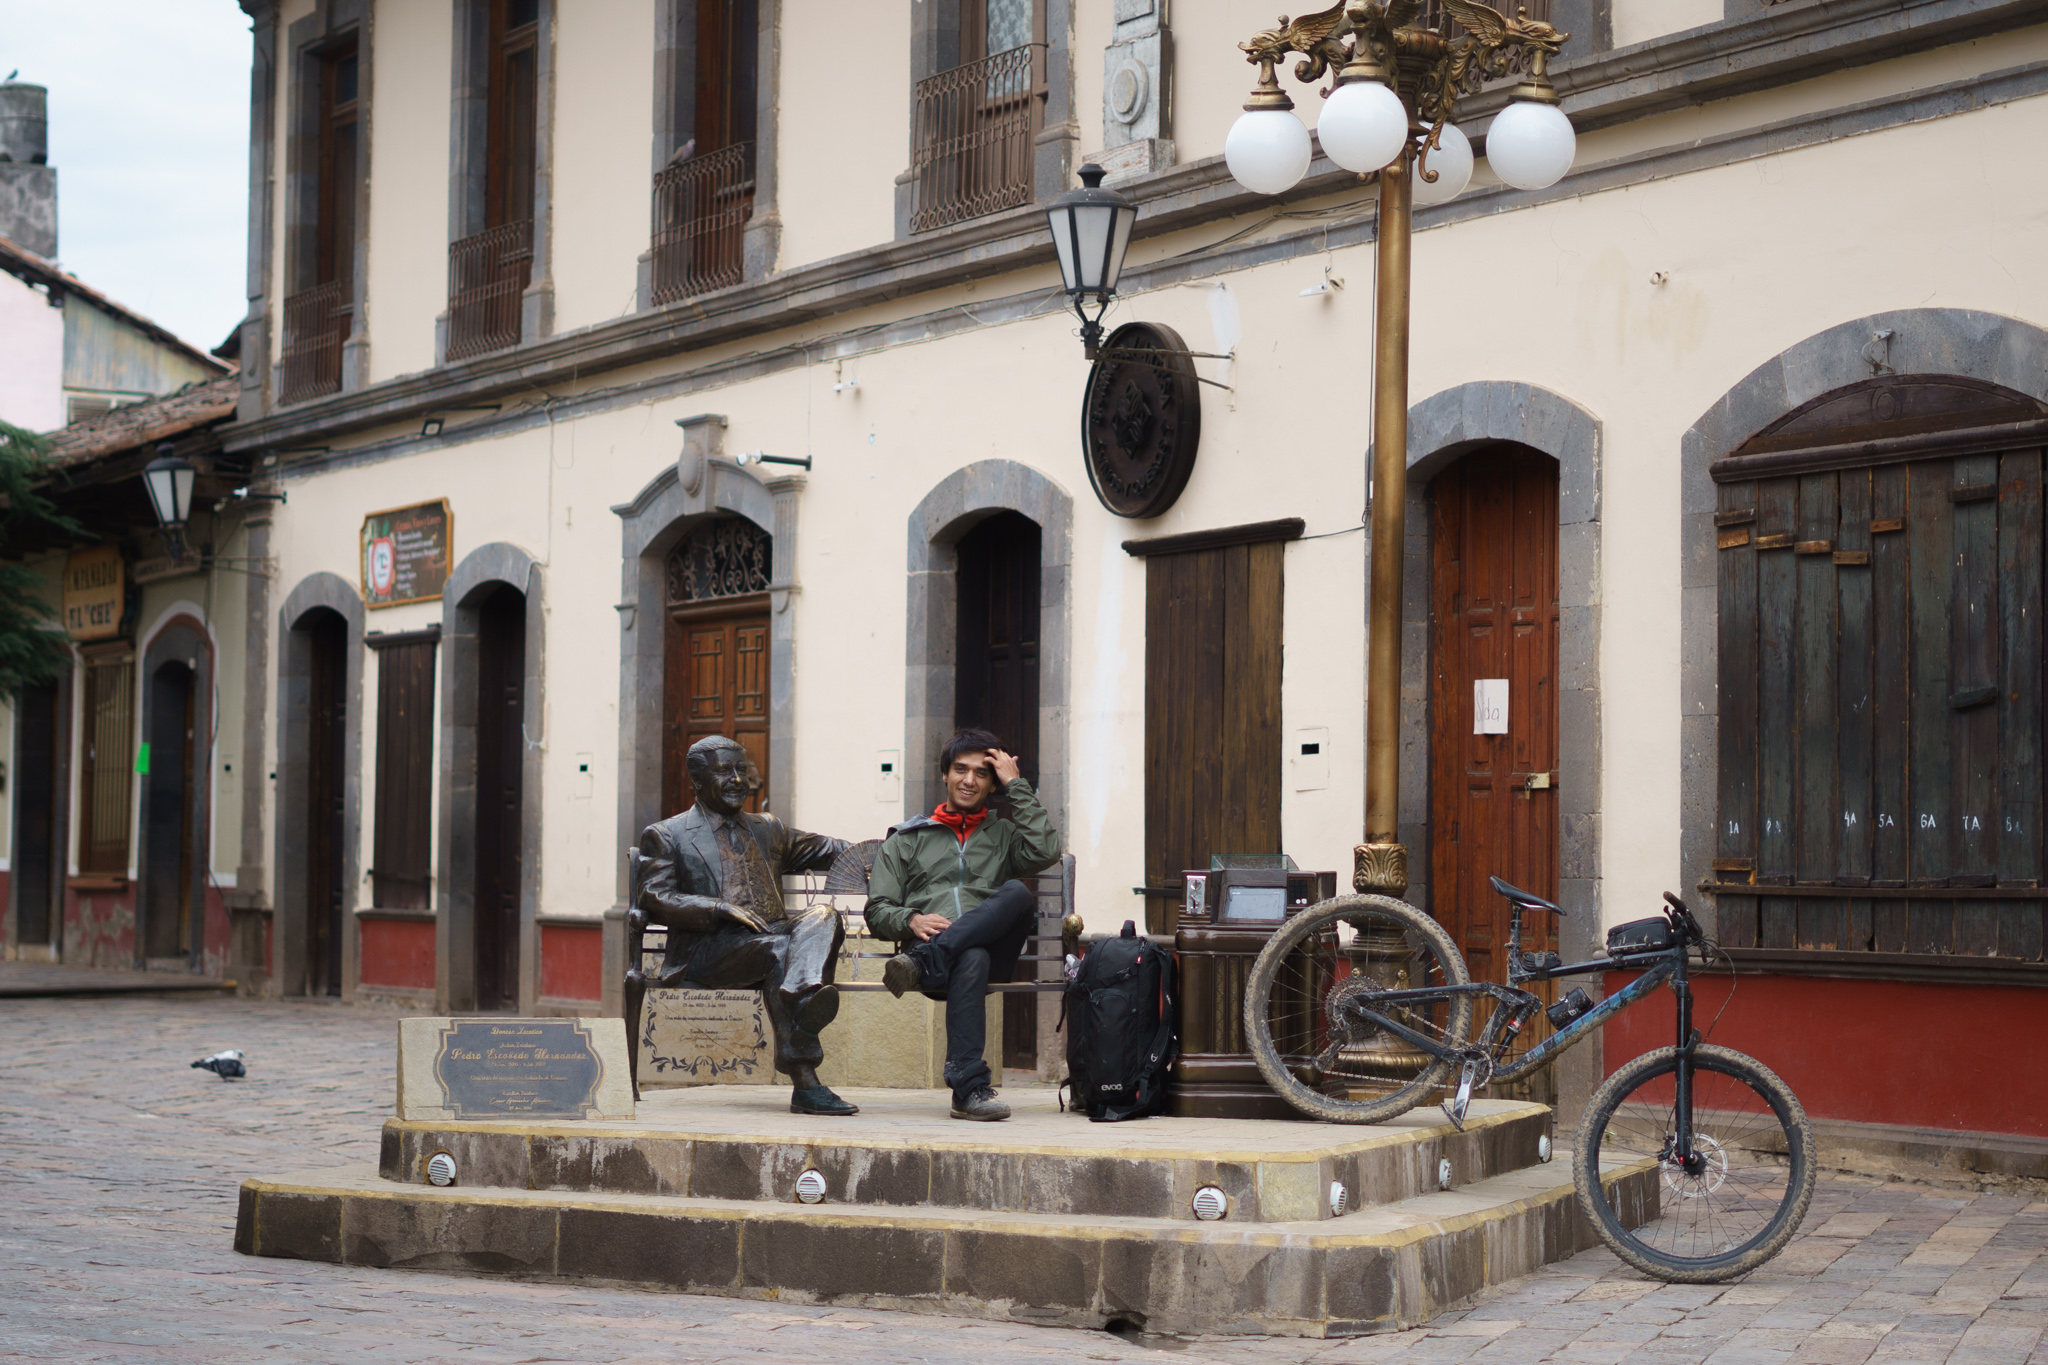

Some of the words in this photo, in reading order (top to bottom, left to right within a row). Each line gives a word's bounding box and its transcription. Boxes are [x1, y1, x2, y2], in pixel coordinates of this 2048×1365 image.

[69, 606, 83, 629] EL
[1728, 820, 1739, 836] 1A
[1844, 811, 1857, 828] 4A
[1878, 813, 1895, 829] 5A
[1920, 813, 1937, 830] 6A
[1962, 815, 1982, 831] 7A
[659, 990, 680, 1000] Pedro
[682, 990, 712, 1001] Escobedo
[714, 990, 751, 1001] Hernández
[450, 1048, 482, 1061] Pedro
[486, 1048, 530, 1061] Escobedo
[533, 1048, 588, 1061] Hernández
[1101, 1083, 1123, 1091] evoc
